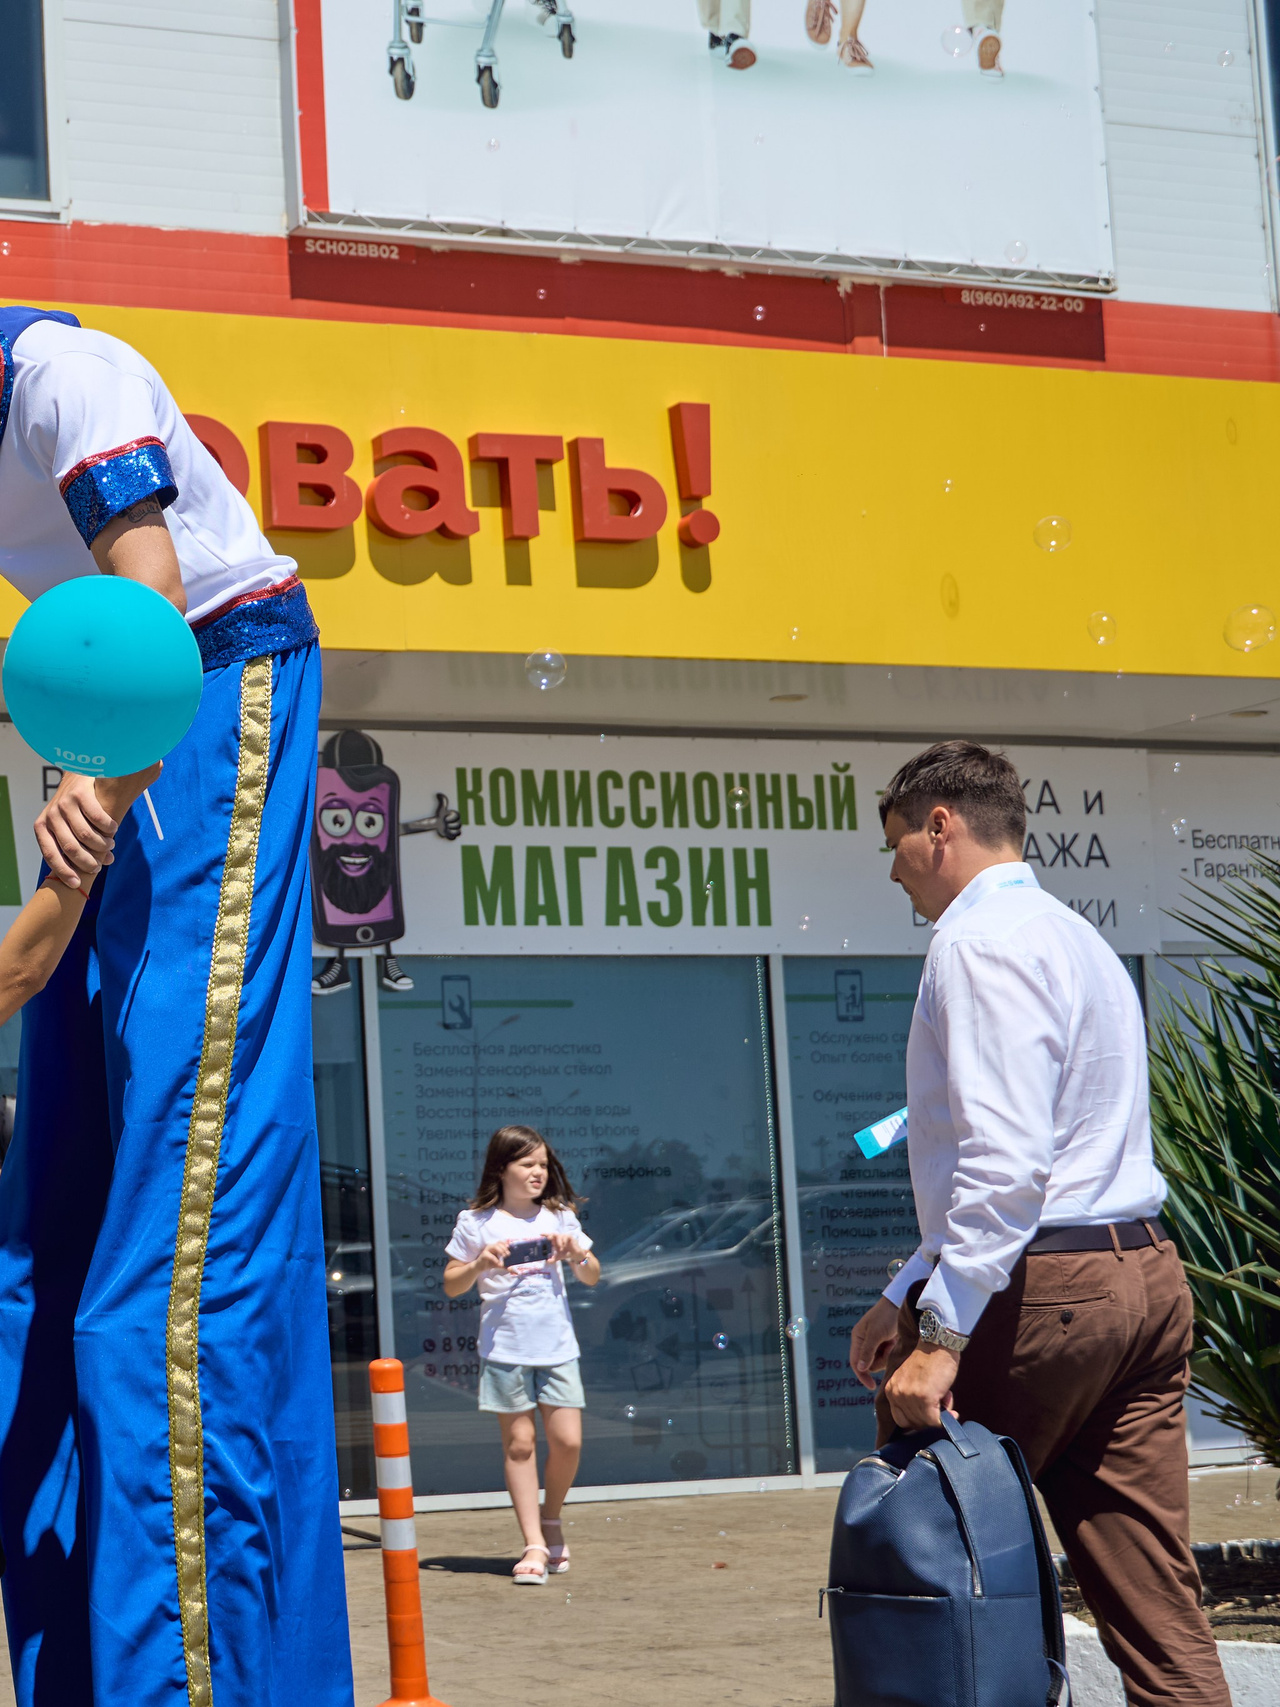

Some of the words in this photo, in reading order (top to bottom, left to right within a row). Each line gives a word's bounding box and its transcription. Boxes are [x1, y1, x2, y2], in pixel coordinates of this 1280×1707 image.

[960, 287, 1085, 313] 8(960)492-22-00
[54, 746, 106, 765] 1000
[455, 762, 858, 831] КОМИССИОННЫЙ
[460, 844, 773, 928] МАГАЗИН
[809, 1030, 888, 1047] Обслужено
[413, 1041, 505, 1057] Бесплатная
[508, 1043, 602, 1058] диагностика
[811, 1050, 847, 1063] Опыт
[851, 1051, 892, 1063] более
[414, 1063, 475, 1078] Замена
[477, 1064, 560, 1079] сенсорных
[415, 1084, 475, 1099] Замена
[479, 1086, 543, 1100] экранов
[813, 1089, 882, 1104] Обучение
[416, 1104, 544, 1119] Восстановление
[547, 1105, 592, 1116] после
[595, 1105, 632, 1117] воды
[569, 1127, 587, 1137] на
[418, 1147, 467, 1160] Пайка
[419, 1169, 476, 1185] Скупка
[594, 1165, 672, 1180] телефонов
[840, 1188, 889, 1199] чтение
[820, 1206, 904, 1221] Проведение
[821, 1225, 877, 1239] Помощь
[824, 1247, 902, 1260] сервисного
[826, 1284, 883, 1297] Помощь
[815, 1357, 841, 1370] Это
[829, 1393, 875, 1406] нашей
